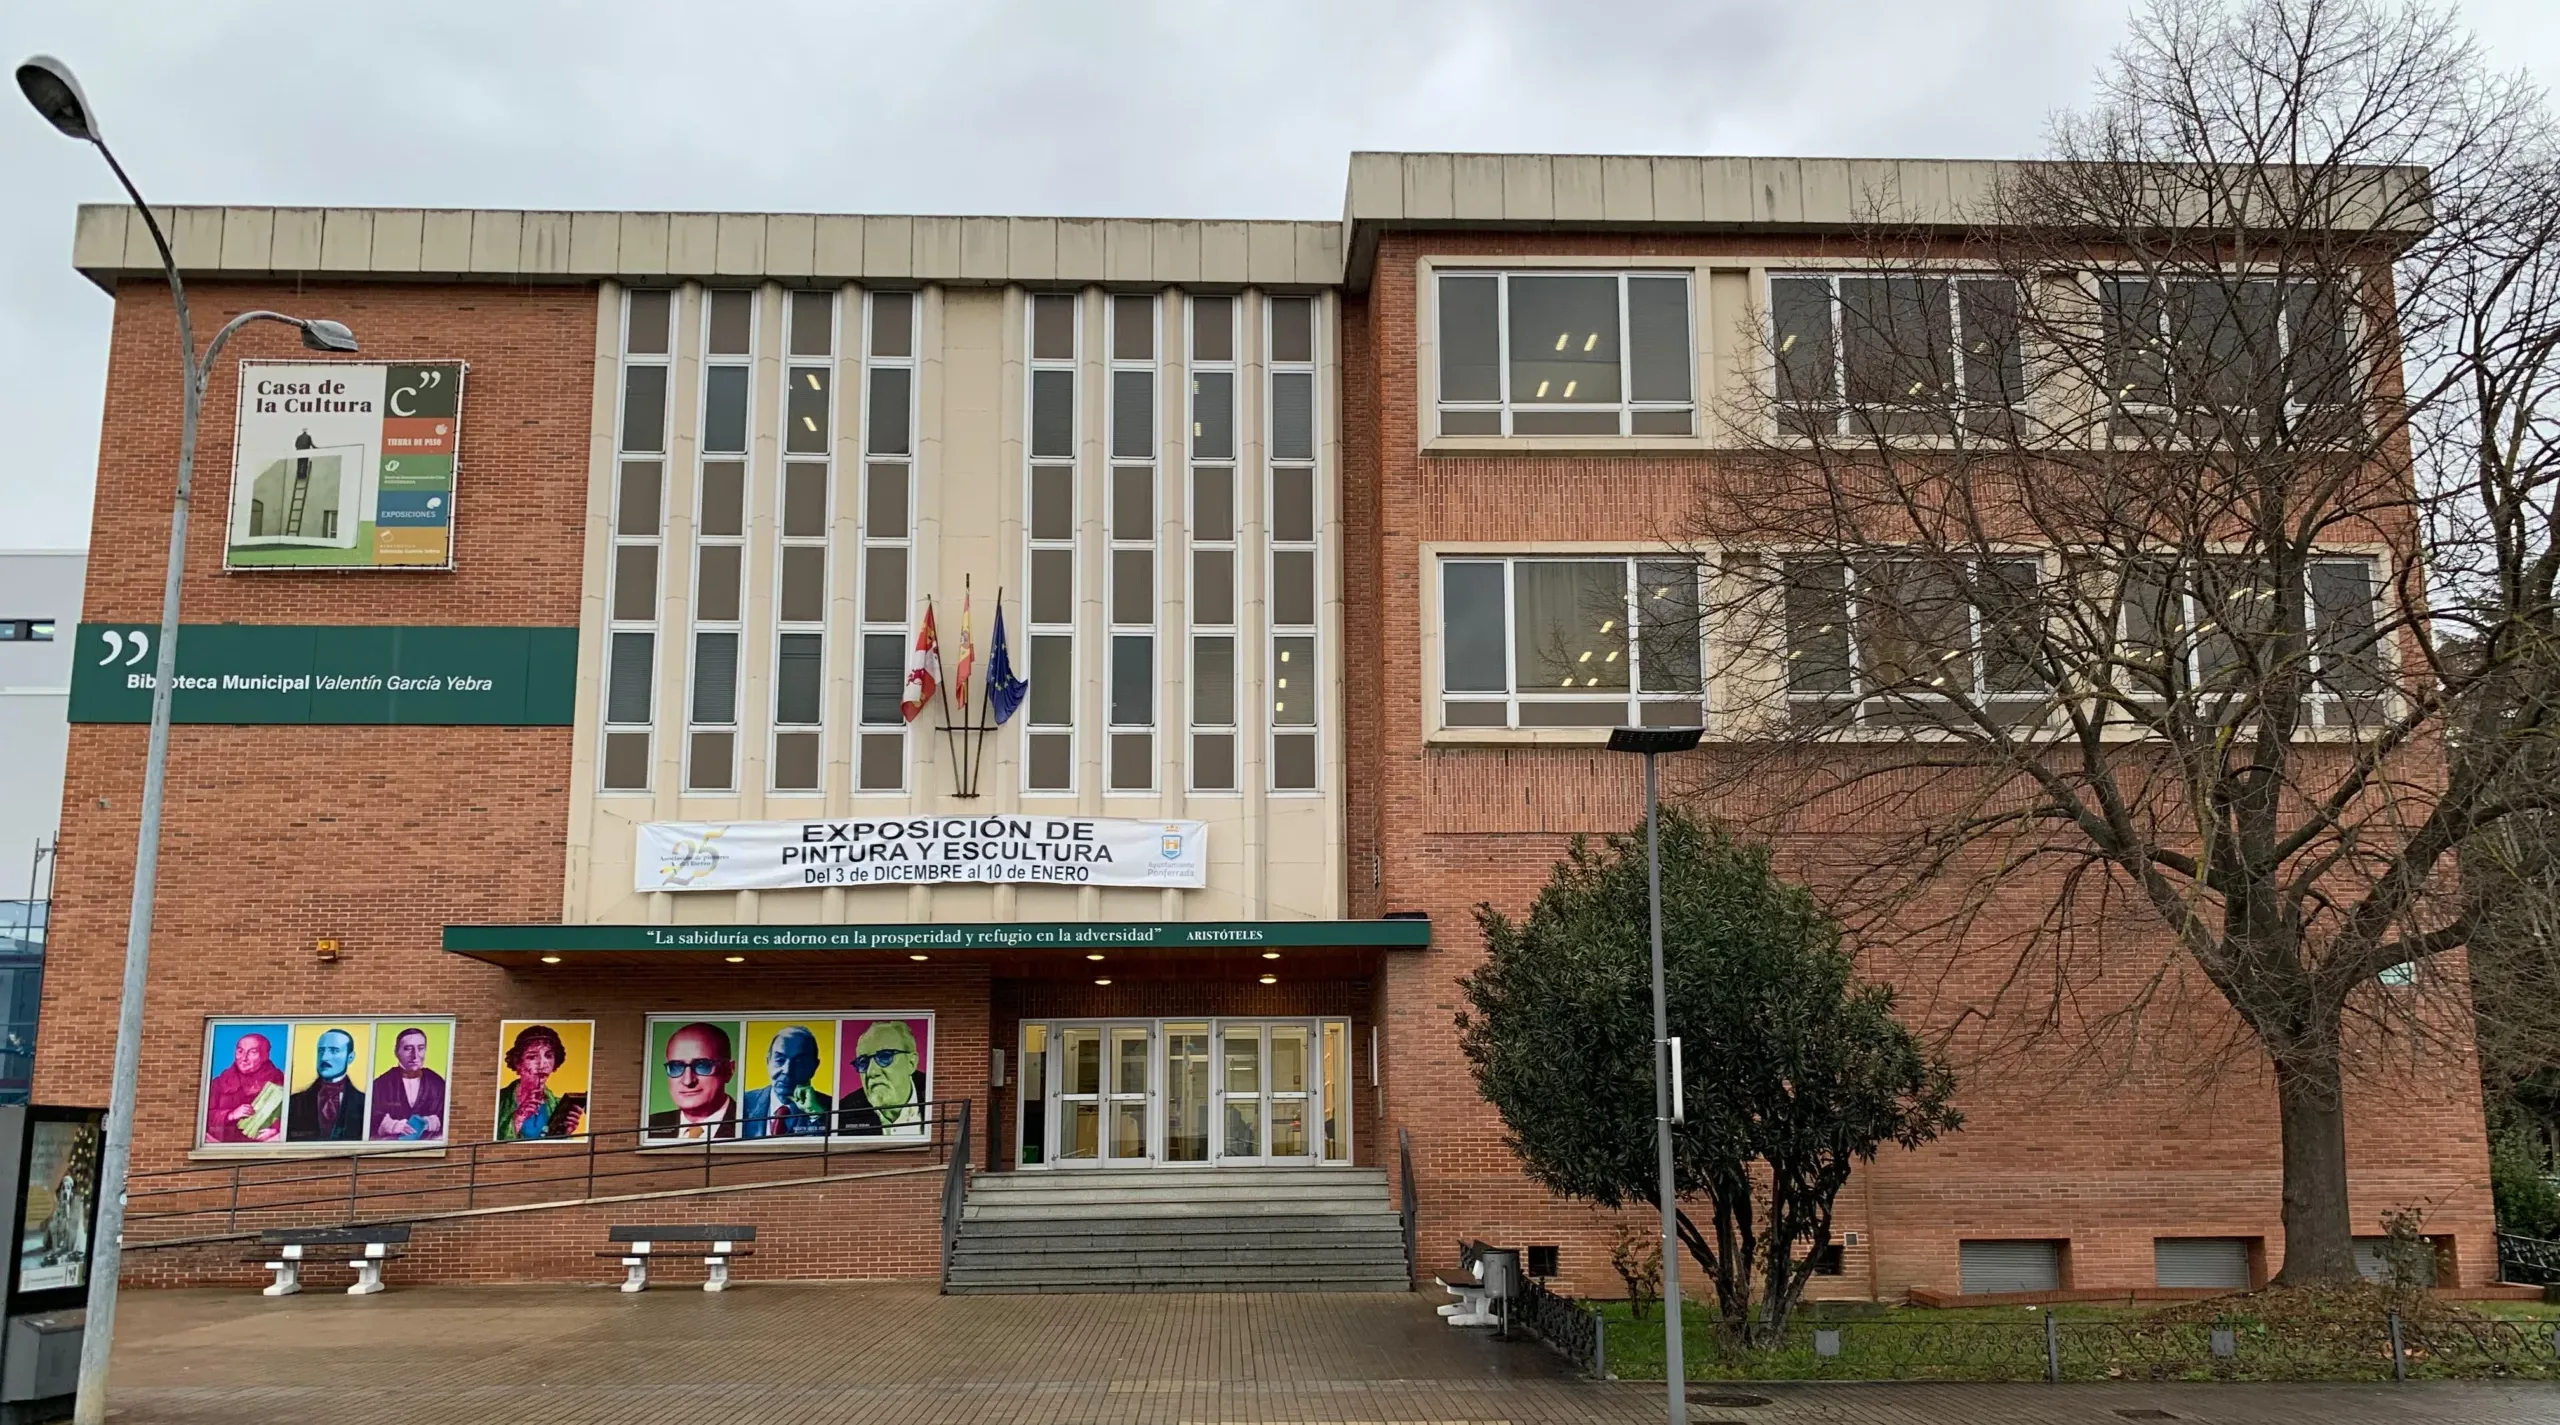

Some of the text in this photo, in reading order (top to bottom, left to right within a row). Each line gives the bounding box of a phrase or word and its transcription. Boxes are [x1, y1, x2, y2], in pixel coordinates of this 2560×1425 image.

[257, 379, 345, 396] Casa de
[256, 398, 373, 413] la Cultura
[387, 438, 442, 446] TIERRA DE PASO
[381, 510, 436, 518] EXPOSICIONES
[127, 673, 493, 694] Biboteca Municipal Valentín García Yebra
[802, 815, 1095, 843] EXPOSICIÓN DE
[782, 841, 1114, 865] PINTURA Y ESCULTURA
[804, 863, 1089, 884] Del 3 de DICEMBRE al 10 de ENERO
[1147, 868, 1195, 878] Ponferrada
[678, 930, 749, 944] sabiduría
[753, 933, 769, 945] es
[773, 931, 827, 944] adorno
[831, 933, 849, 944] en
[853, 930, 867, 944] la
[871, 929, 961, 947] prosperidad
[965, 932, 974, 946] y
[978, 929, 1032, 946] refugio
[1036, 931, 1054, 942] en
[1058, 928, 1071, 942] la
[1186, 928, 1263, 941] ARISTÓTELES
